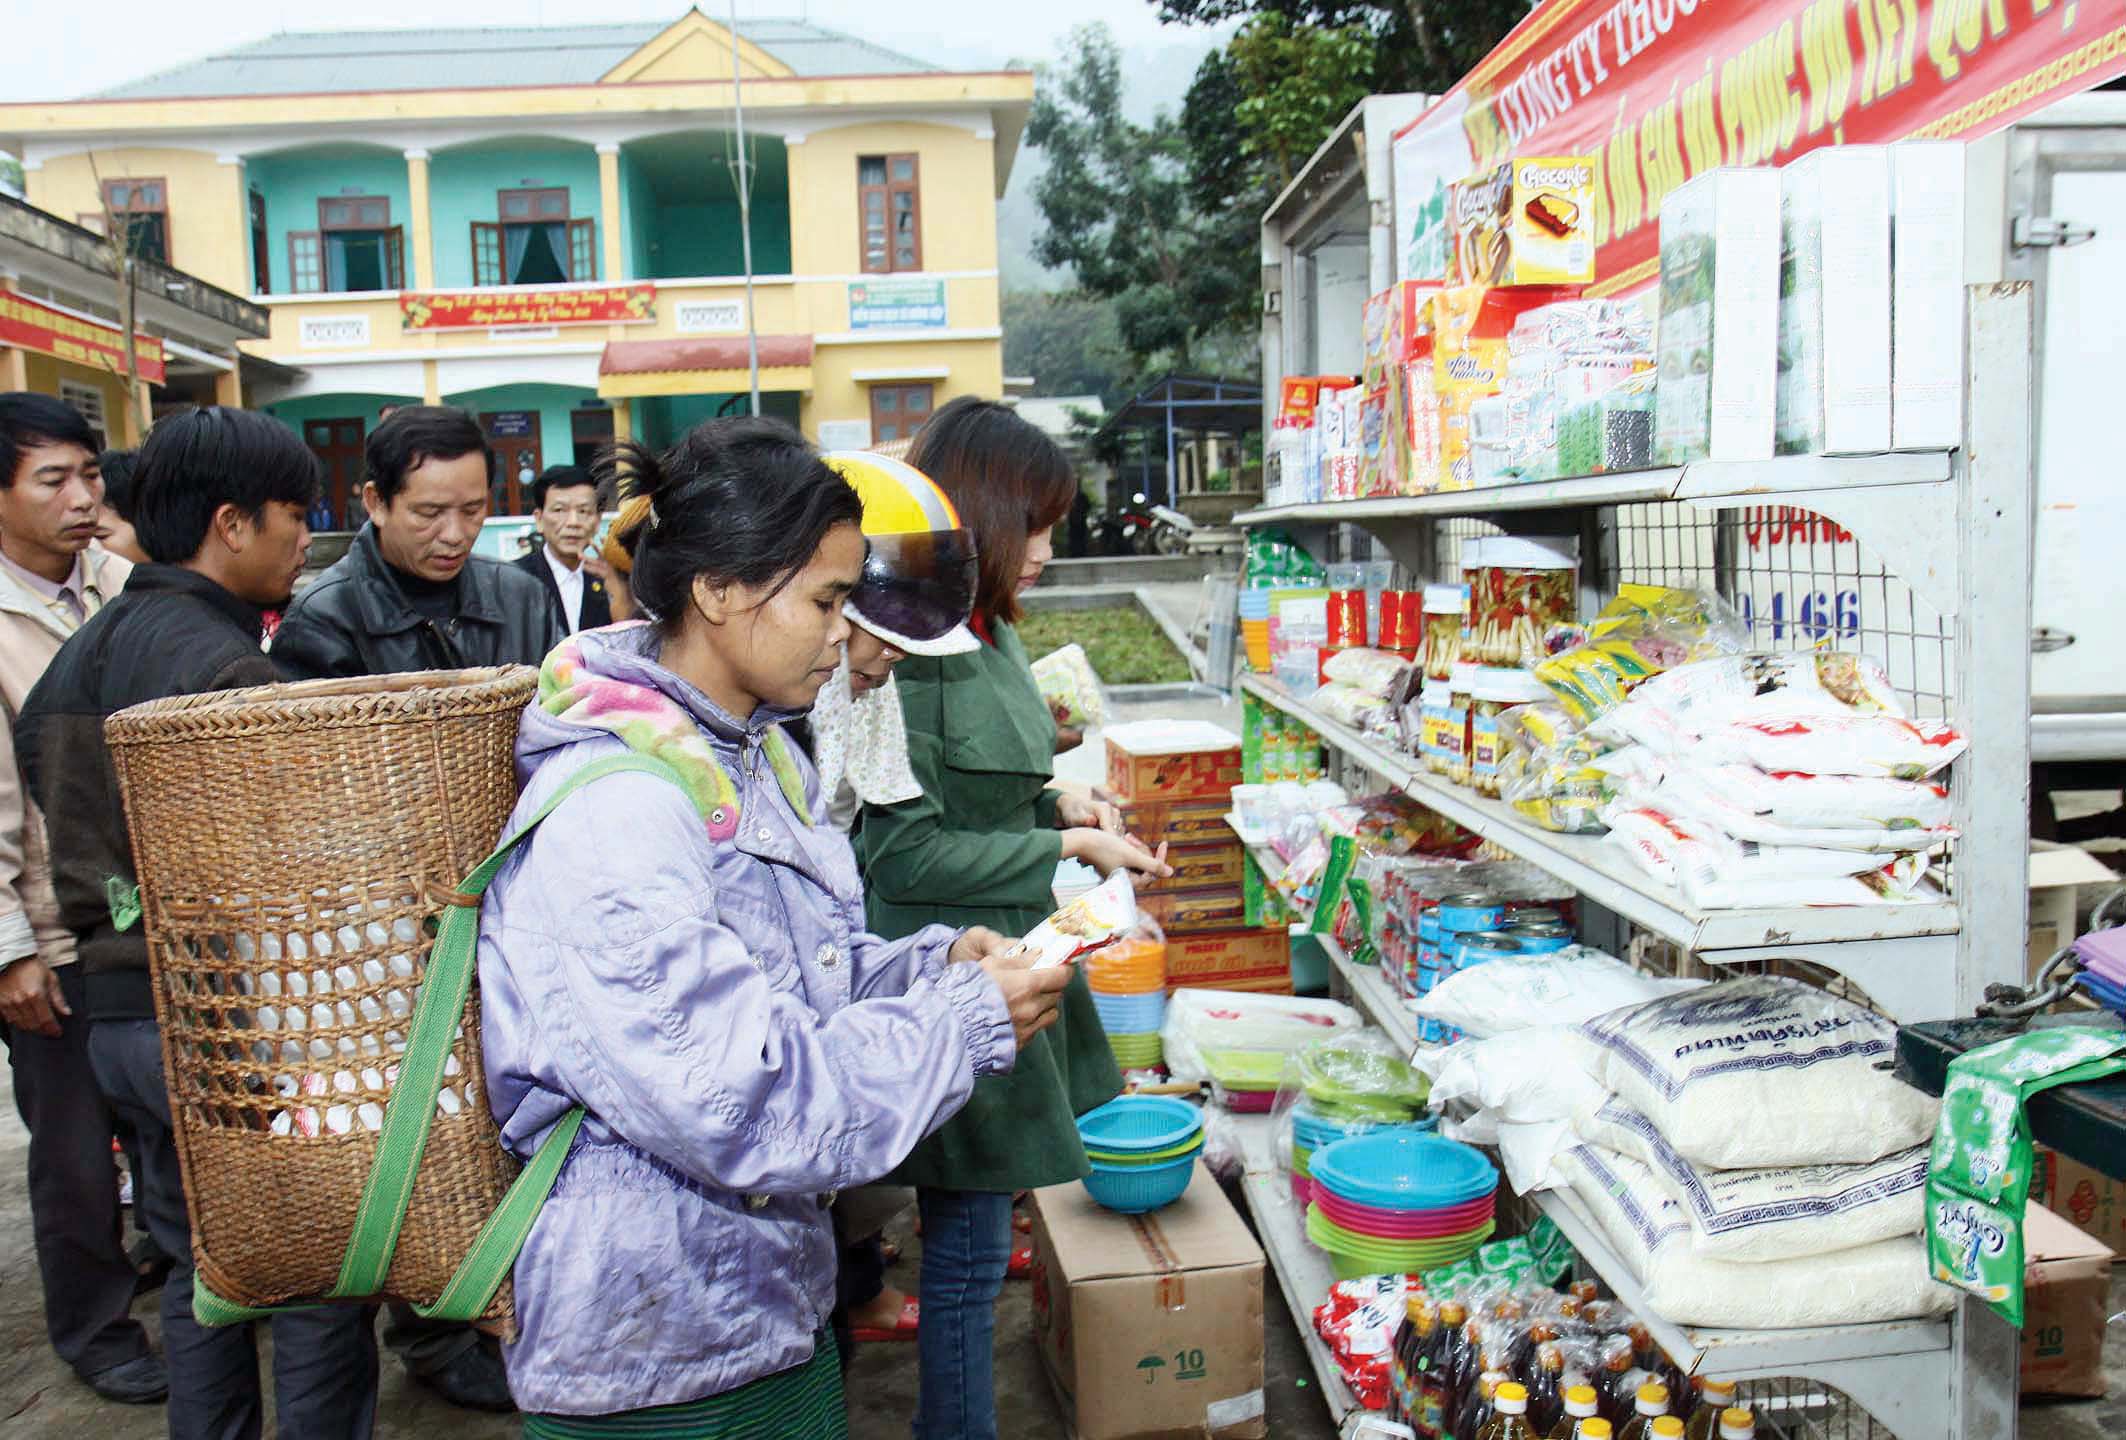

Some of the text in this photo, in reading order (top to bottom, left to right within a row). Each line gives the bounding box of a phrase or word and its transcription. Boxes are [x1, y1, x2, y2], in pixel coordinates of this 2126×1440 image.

[1938, 1206, 2005, 1254] Comfort
[2036, 1328, 2063, 1347] 10
[1174, 1348, 1206, 1371] 10
